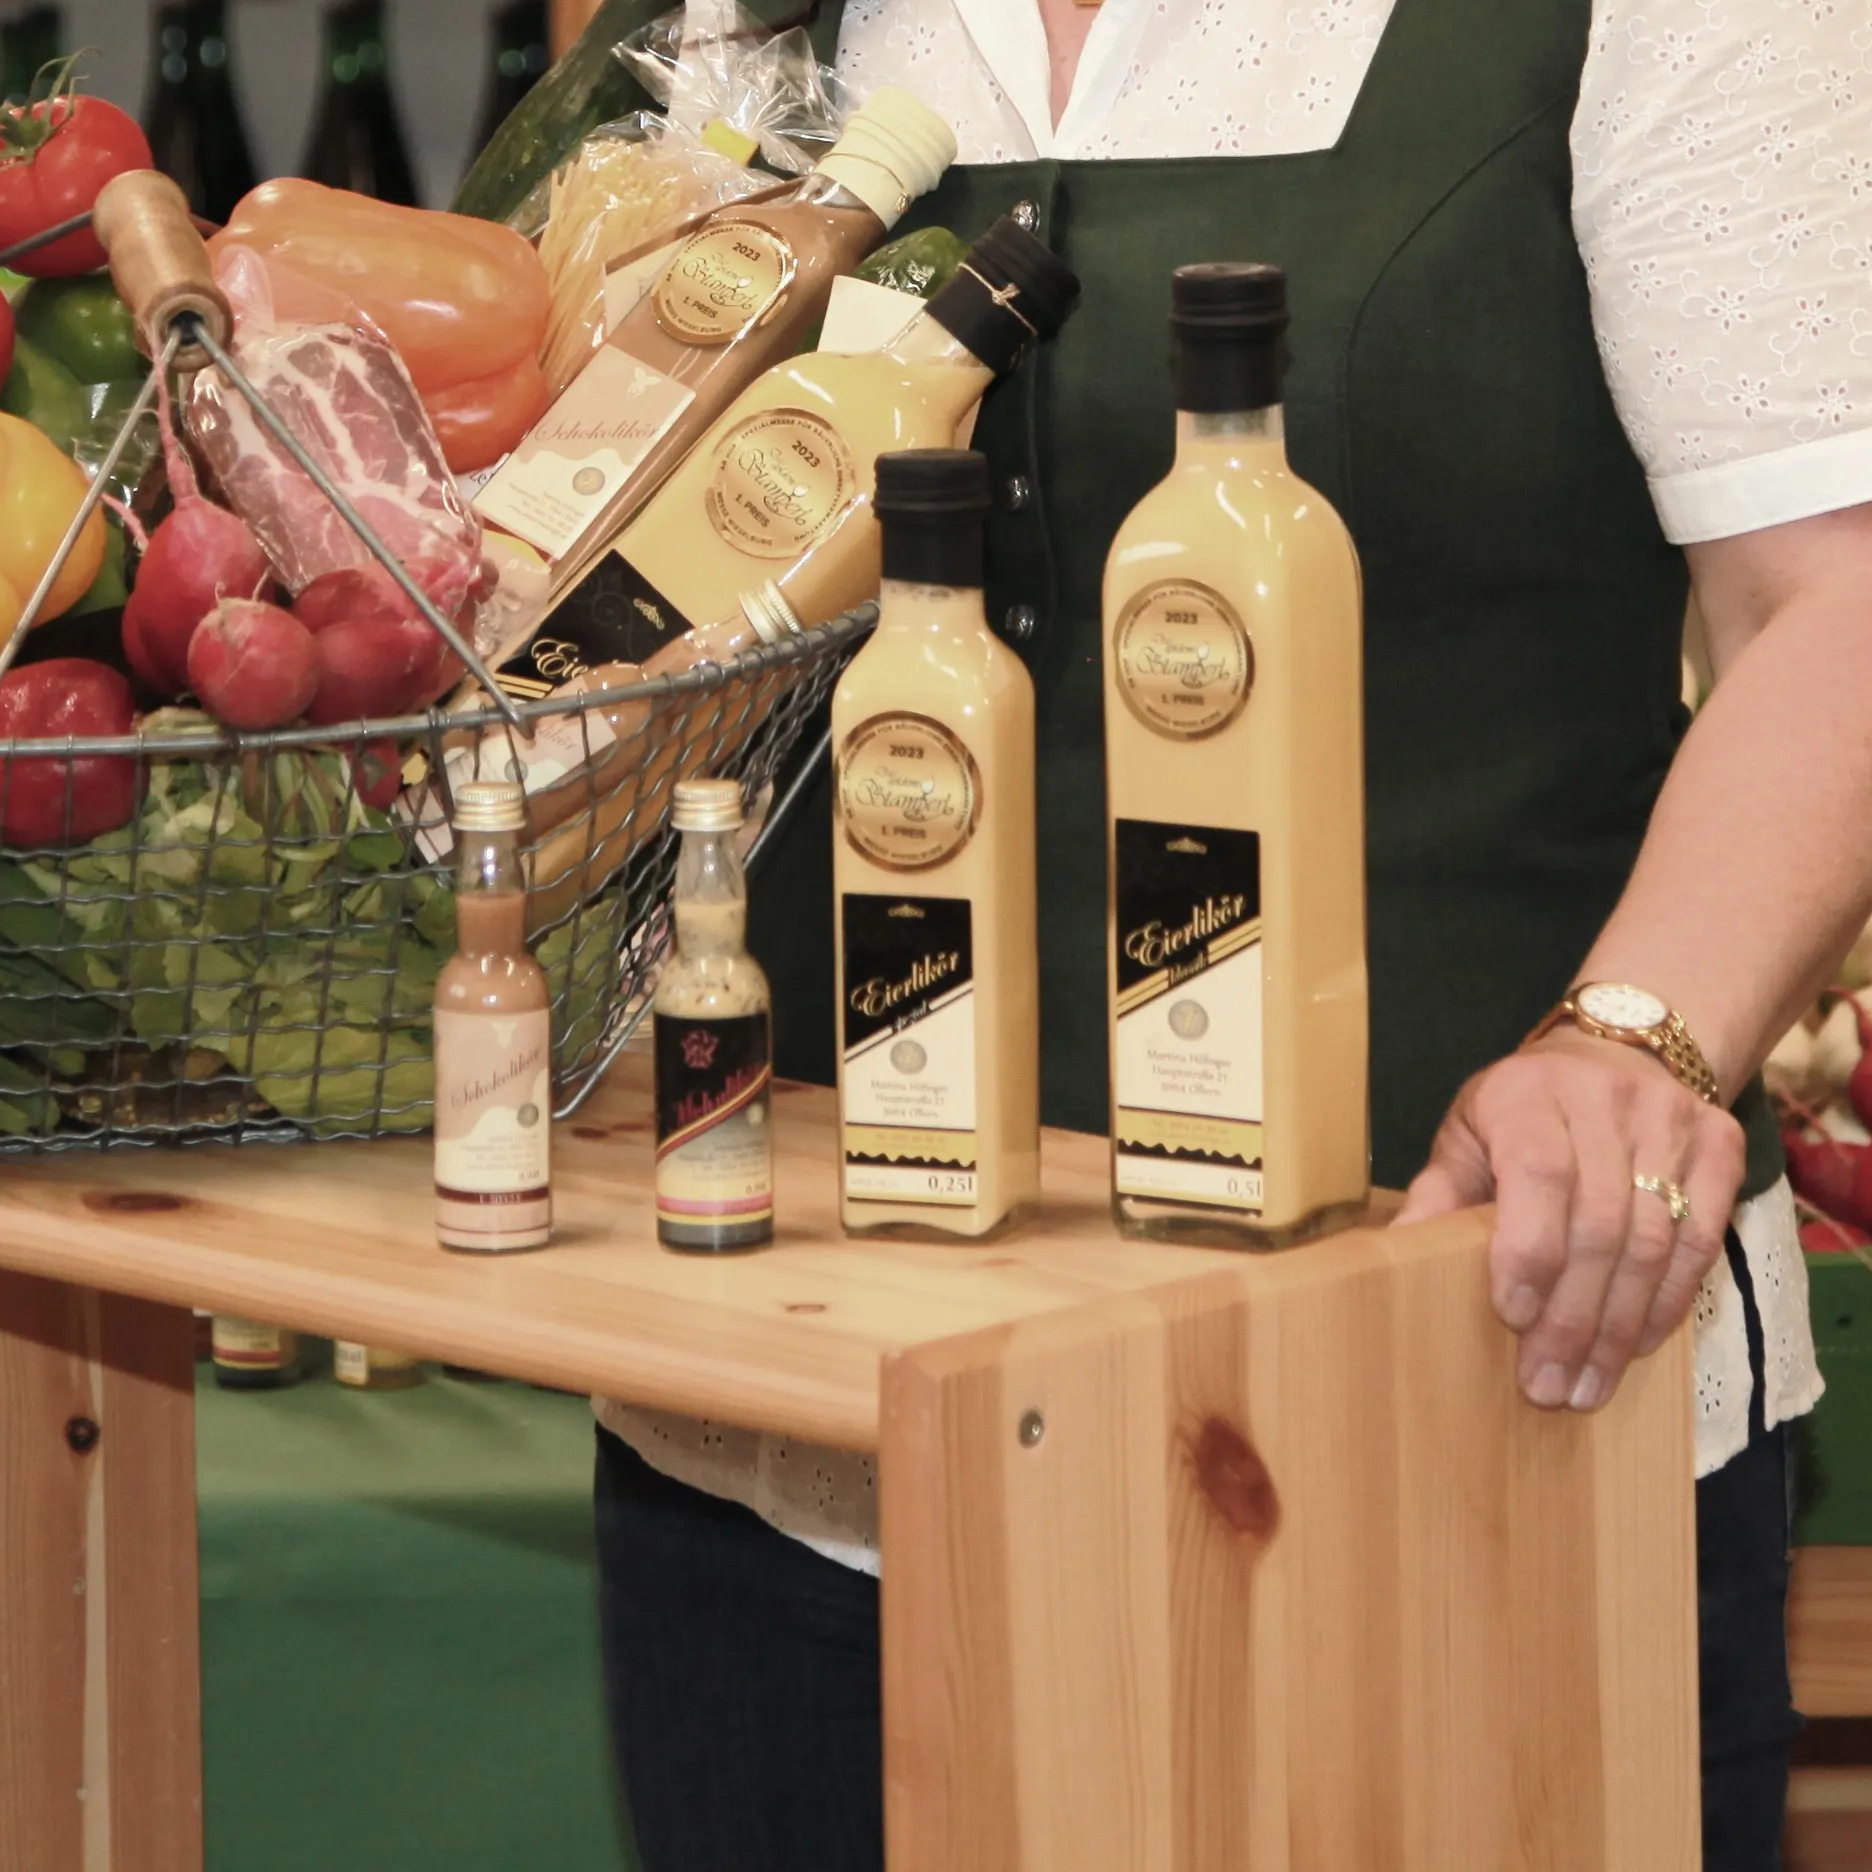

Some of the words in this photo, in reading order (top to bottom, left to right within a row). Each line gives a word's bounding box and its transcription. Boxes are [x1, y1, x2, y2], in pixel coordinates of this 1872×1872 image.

[731, 241, 761, 262] 2023
[691, 300, 719, 319] PREIS
[534, 419, 659, 443] Schokolikör
[791, 440, 821, 469] 2023
[743, 499, 771, 528] PREIS
[1164, 611, 1199, 626] 2023
[889, 744, 925, 760] 2023
[1125, 893, 1247, 967] Eierlikör
[850, 951, 960, 1017] Eierlikör
[928, 1174, 974, 1194] 0,25l
[1227, 1178, 1262, 1200] 0,5l
